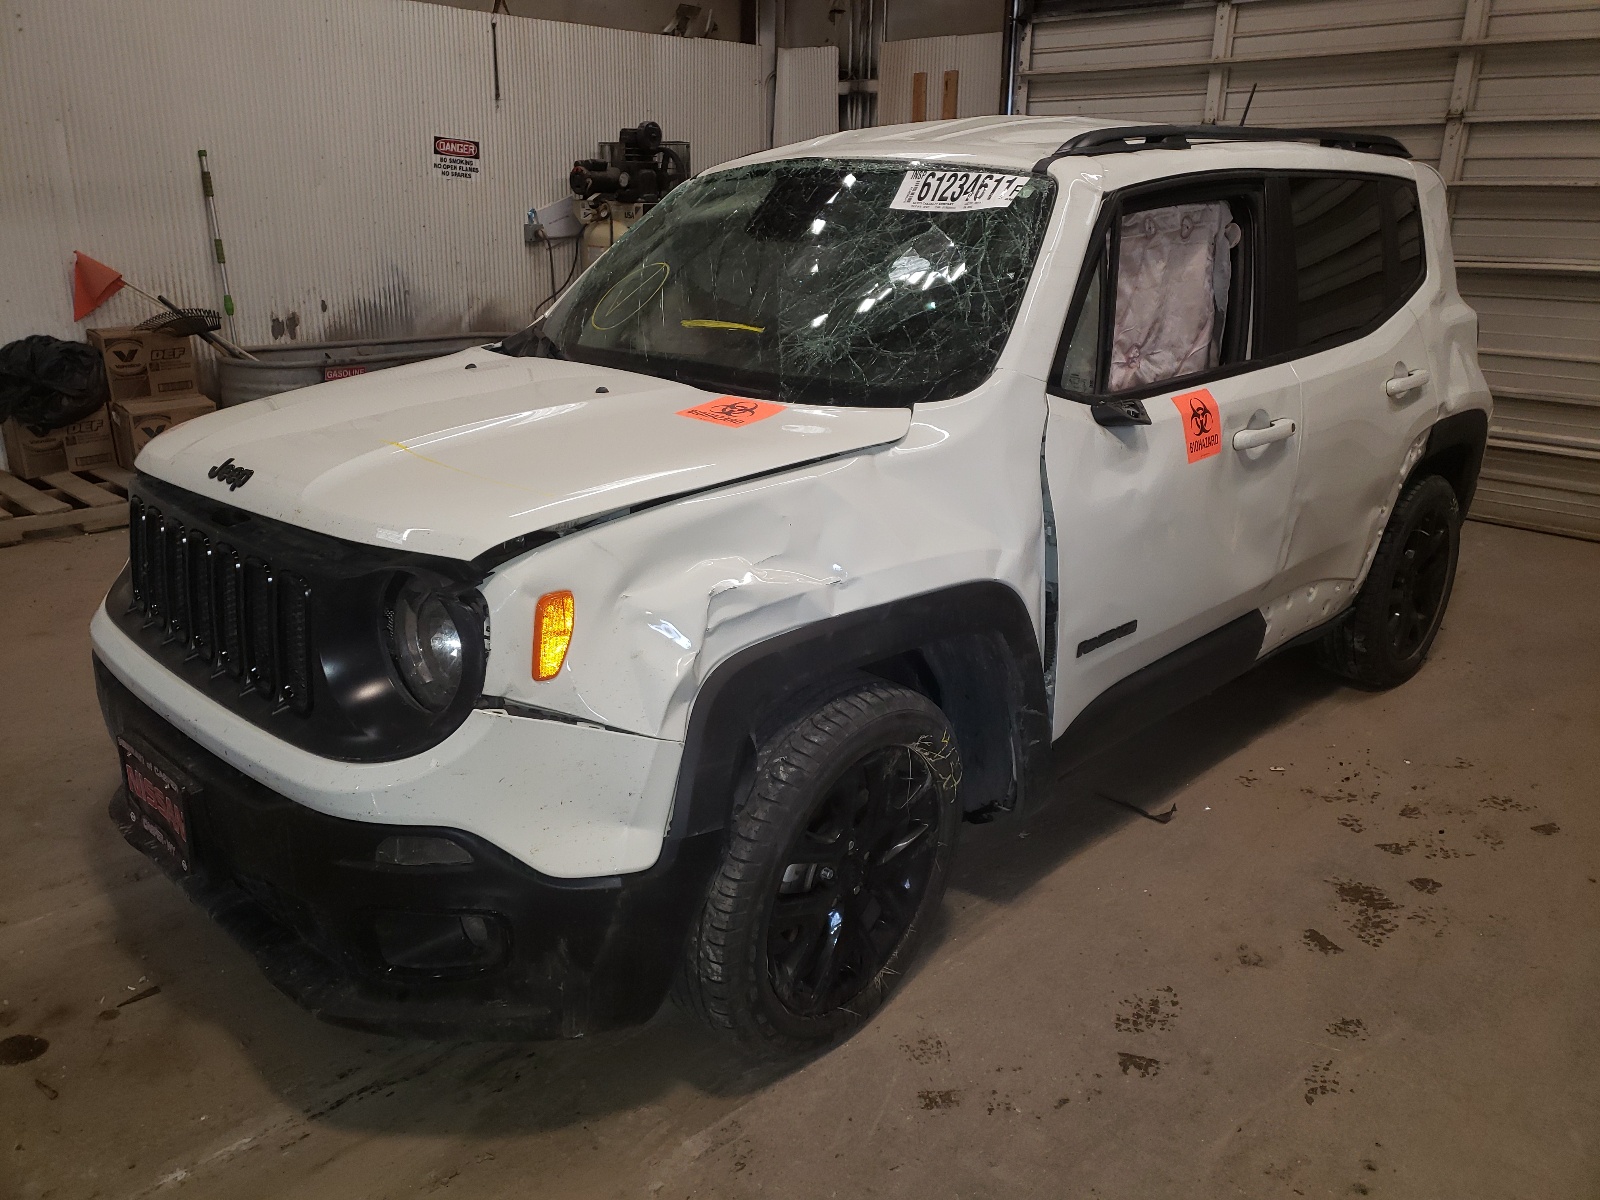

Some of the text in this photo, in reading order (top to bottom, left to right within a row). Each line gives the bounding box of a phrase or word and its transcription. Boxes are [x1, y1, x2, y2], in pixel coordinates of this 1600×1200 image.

[440, 141, 475, 155] DANGER
[449, 158, 473, 166] SMOKING
[624, 211, 635, 219] USA
[151, 347, 186, 361] DEF
[326, 369, 365, 379] GASOLINE
[66, 419, 104, 434] DEF
[1189, 433, 1219, 454] BIOHAZARD
[207, 457, 255, 492] Jeep
[126, 763, 187, 843] NISSAN
